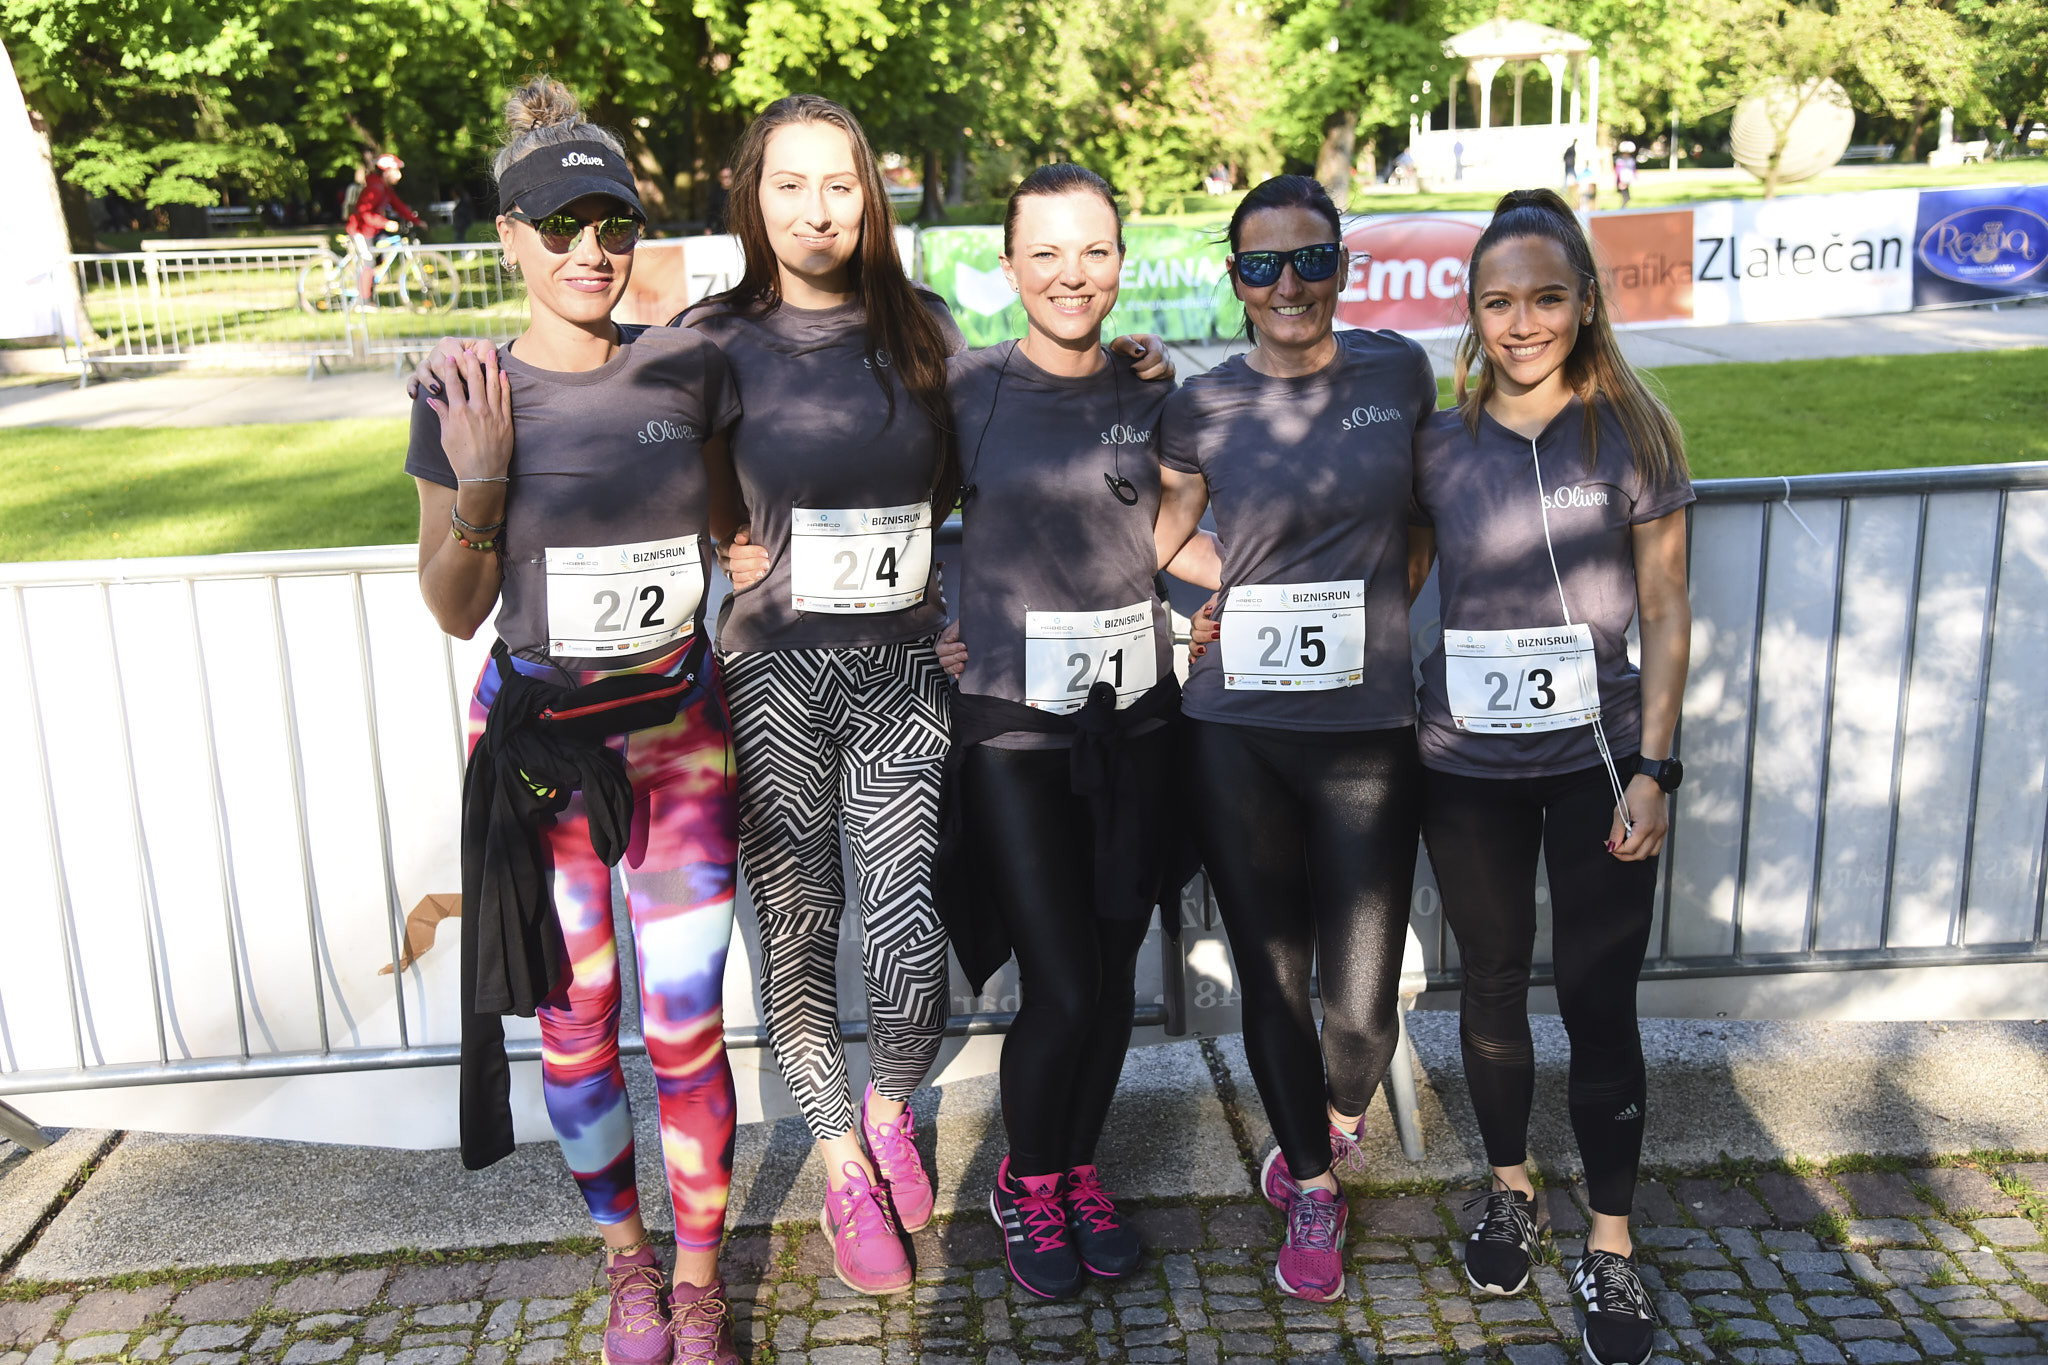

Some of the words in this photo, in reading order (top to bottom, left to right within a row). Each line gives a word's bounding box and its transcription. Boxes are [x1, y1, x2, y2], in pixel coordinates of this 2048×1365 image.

[561, 152, 605, 167] s.Oliver
[1698, 233, 1902, 281] Zlatečan
[1339, 251, 1470, 302] Emc
[637, 420, 696, 444] s.Oliver
[1101, 424, 1151, 445] s.Olive
[1543, 485, 1610, 509] s.Oliver
[872, 512, 921, 526] BIZNISRUN
[633, 547, 686, 563] BIZNISRUN
[833, 547, 899, 591] 2/4
[1292, 590, 1351, 603] BIZNISRUN
[593, 585, 665, 633] 2/2
[1104, 612, 1145, 629] BIZNISRUN
[1258, 625, 1326, 668] 2/5
[1066, 648, 1123, 693] 2/1
[1484, 668, 1556, 712] 2/3
